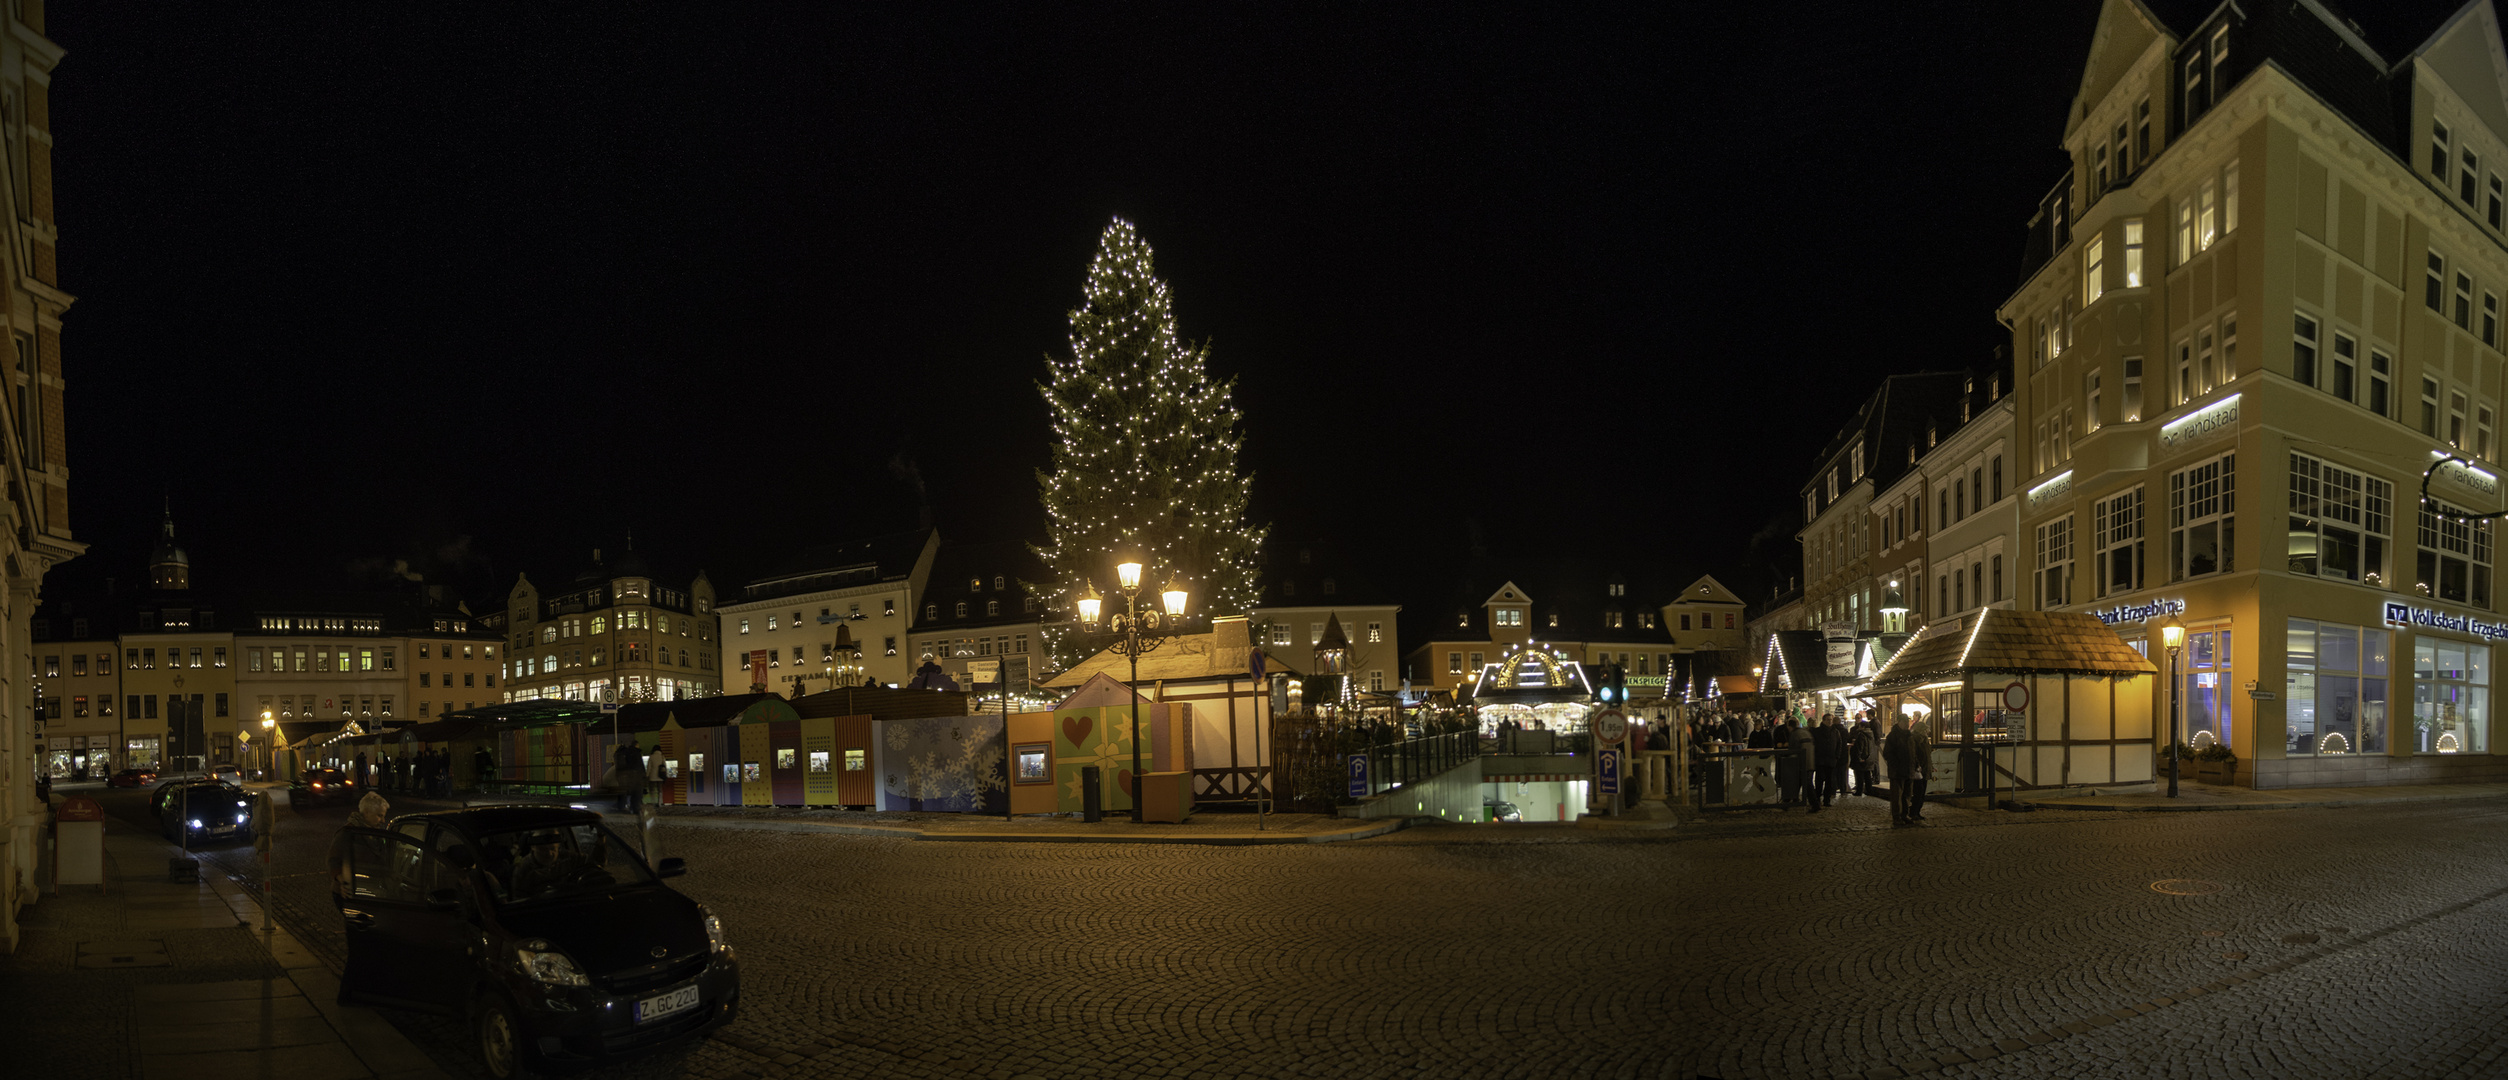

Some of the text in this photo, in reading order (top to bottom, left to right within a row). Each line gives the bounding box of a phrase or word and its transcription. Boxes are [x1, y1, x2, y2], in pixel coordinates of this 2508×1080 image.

[2184, 401, 2238, 440] randstad
[2454, 469, 2495, 495] randstad
[2094, 607, 2120, 625] bank
[2411, 607, 2469, 632] Volksbank
[1355, 763, 1363, 778] P
[1604, 758, 1613, 774] P
[641, 988, 697, 1018] Z GC 220
